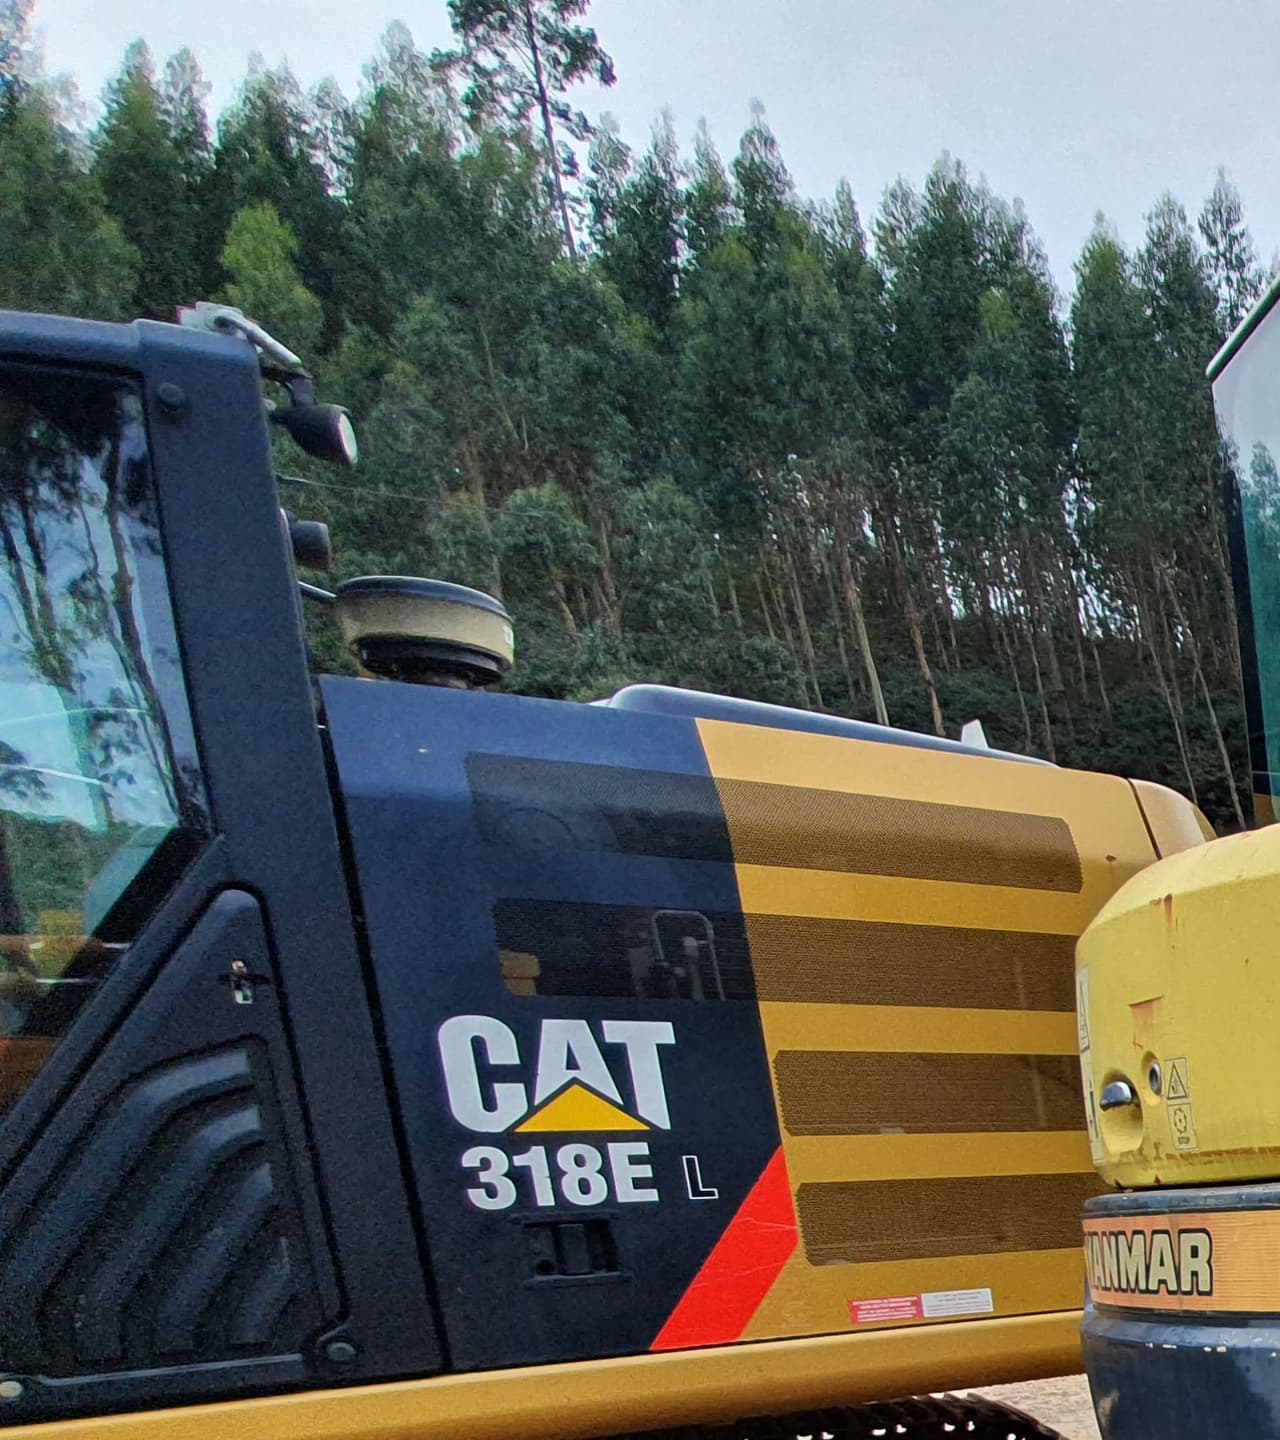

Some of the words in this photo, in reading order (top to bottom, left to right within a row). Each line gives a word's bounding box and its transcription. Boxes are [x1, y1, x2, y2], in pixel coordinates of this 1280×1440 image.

[437, 1014, 676, 1133] CAT
[461, 1141, 659, 1210] 318E
[682, 1155, 719, 1199] L
